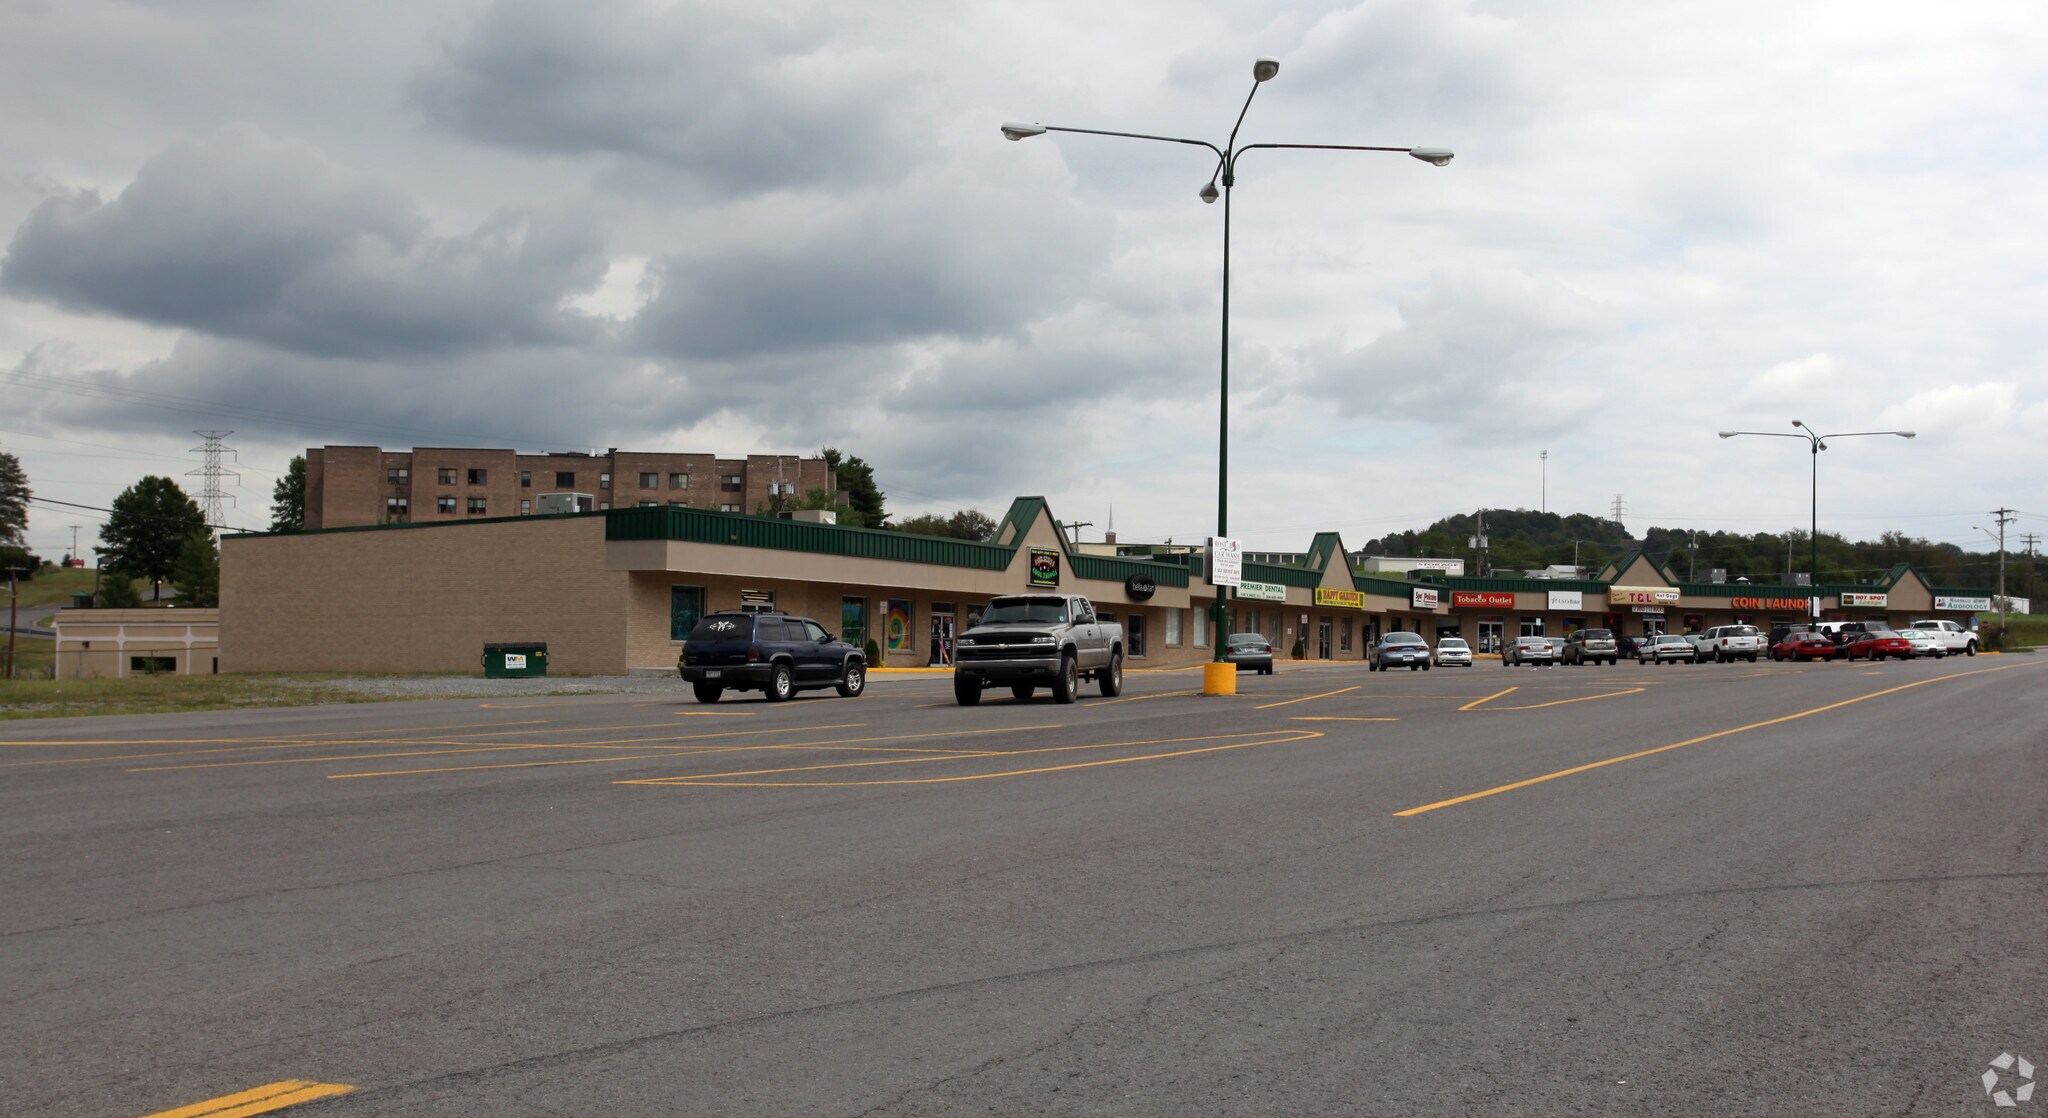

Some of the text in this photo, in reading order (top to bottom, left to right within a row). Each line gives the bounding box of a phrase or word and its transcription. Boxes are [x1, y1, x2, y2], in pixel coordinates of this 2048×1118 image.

[1225, 552, 1241, 560] WASH
[1240, 582, 1284, 594] PREMIER DENTAL
[1322, 589, 1359, 602] HAPPY GARDEN
[1457, 594, 1513, 604] Tobacco Outlet
[1731, 596, 1762, 609] COIN
[1947, 602, 1988, 610] AUDIOLOGY
